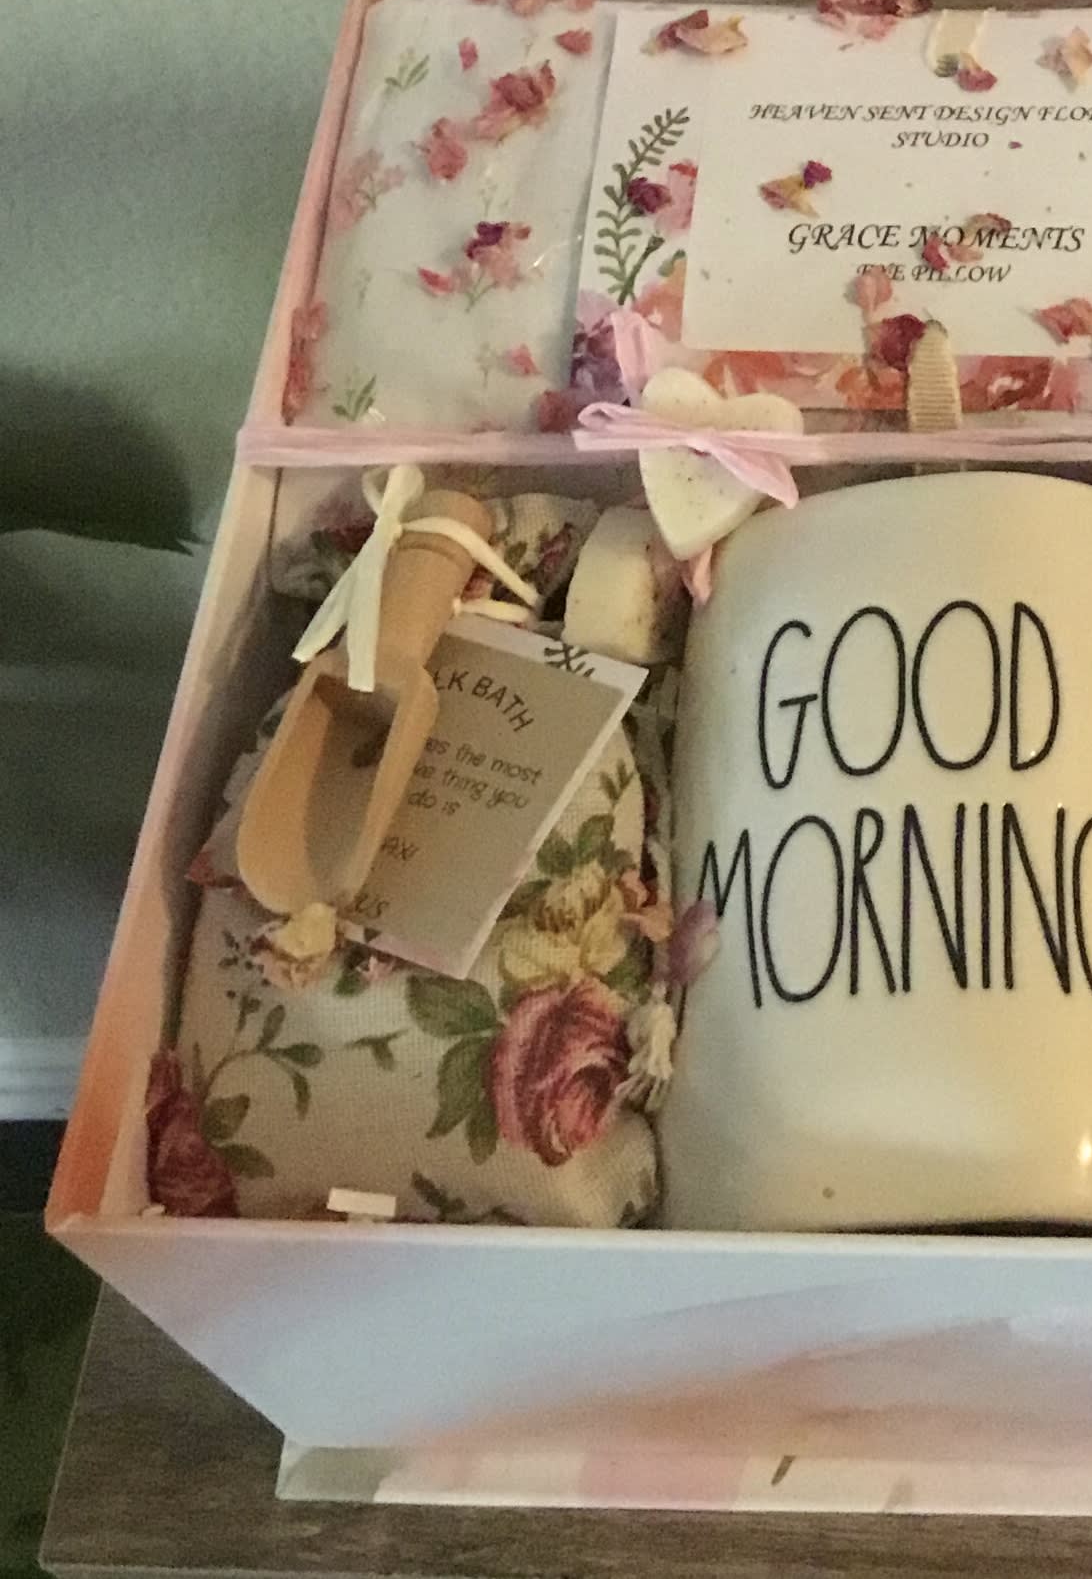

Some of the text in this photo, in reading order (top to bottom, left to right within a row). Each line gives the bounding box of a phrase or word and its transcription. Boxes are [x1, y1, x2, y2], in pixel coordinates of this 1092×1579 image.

[749, 103, 863, 122] HEAVEN
[862, 105, 928, 122] SENT
[932, 104, 1034, 126] DESIGN
[891, 131, 990, 149] STUDIO
[788, 223, 901, 254] GRACE
[471, 675, 536, 733] BATH
[758, 599, 1060, 790] GOOD
[455, 743, 487, 768] the
[490, 757, 544, 787] most
[485, 787, 530, 810] you
